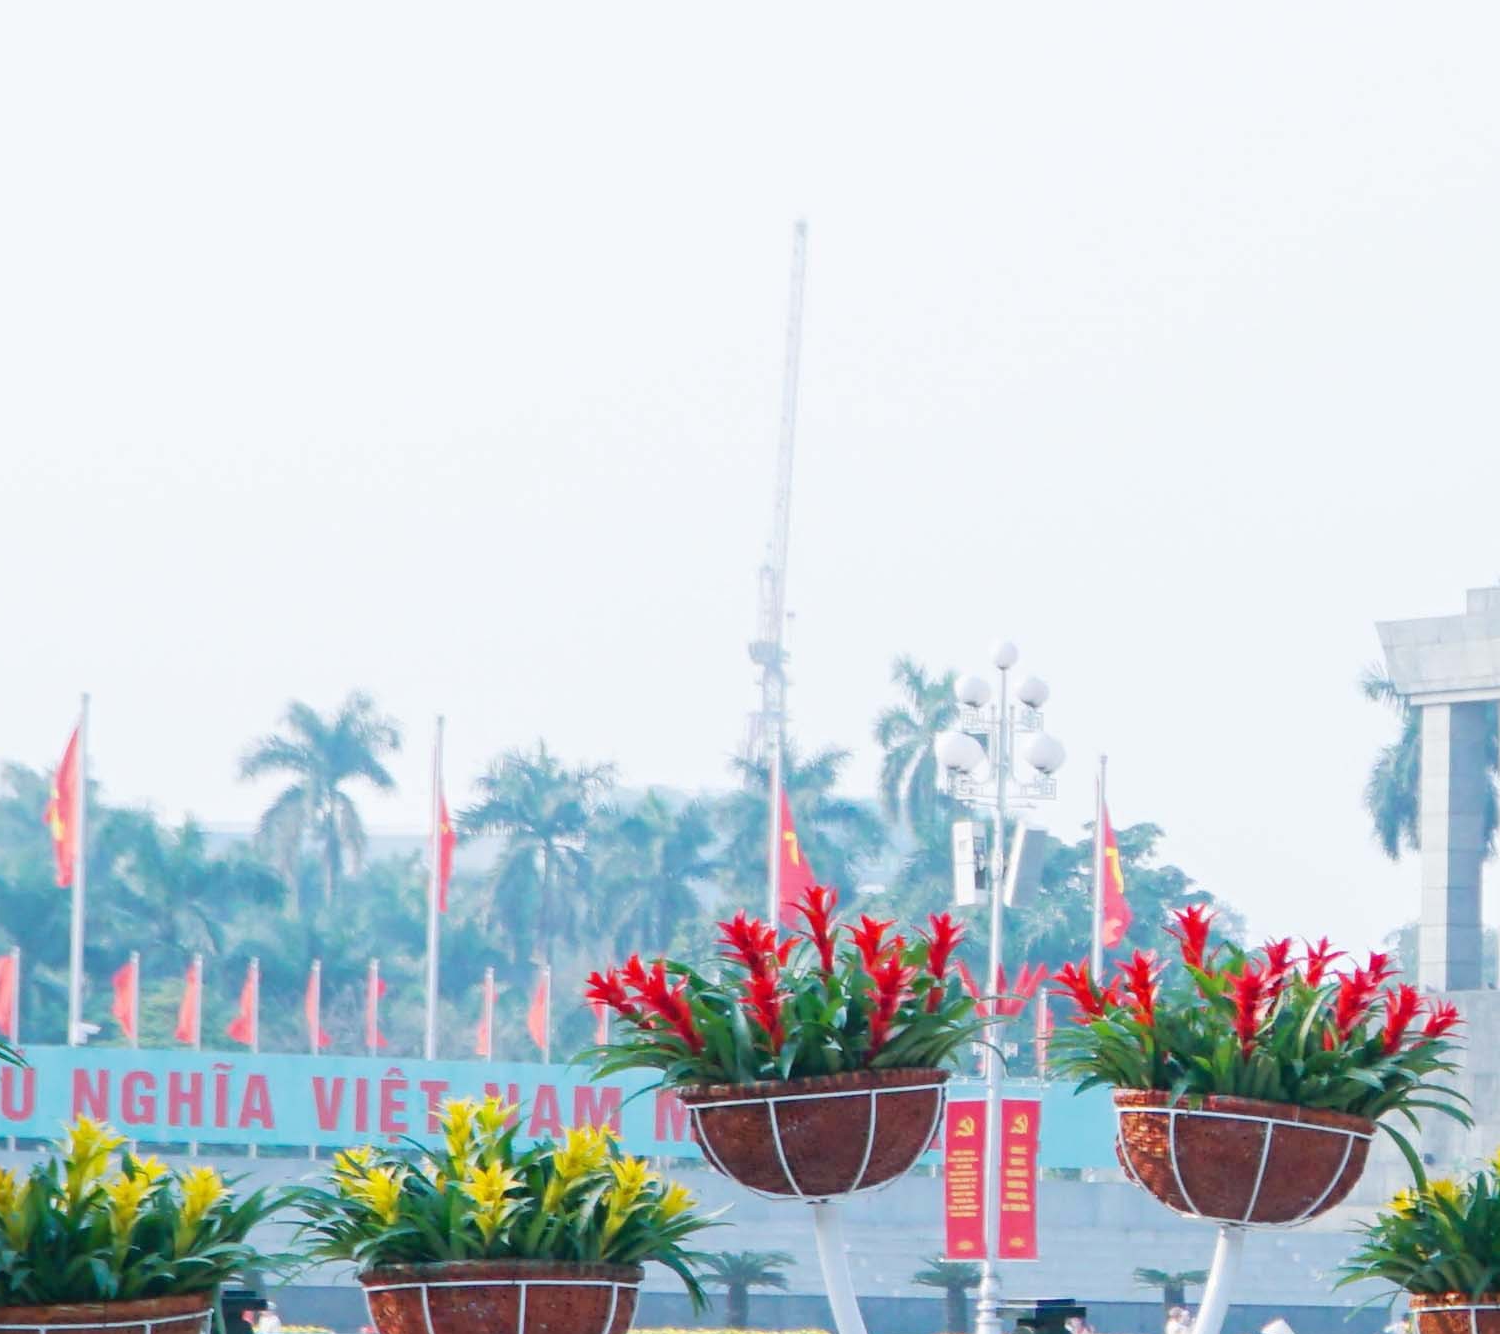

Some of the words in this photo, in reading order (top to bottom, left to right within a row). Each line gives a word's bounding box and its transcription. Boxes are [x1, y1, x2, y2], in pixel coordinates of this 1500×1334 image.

[72, 1063, 275, 1129] NGHĨA
[312, 1067, 450, 1143] VIỆT
[484, 1082, 622, 1138] NAM
